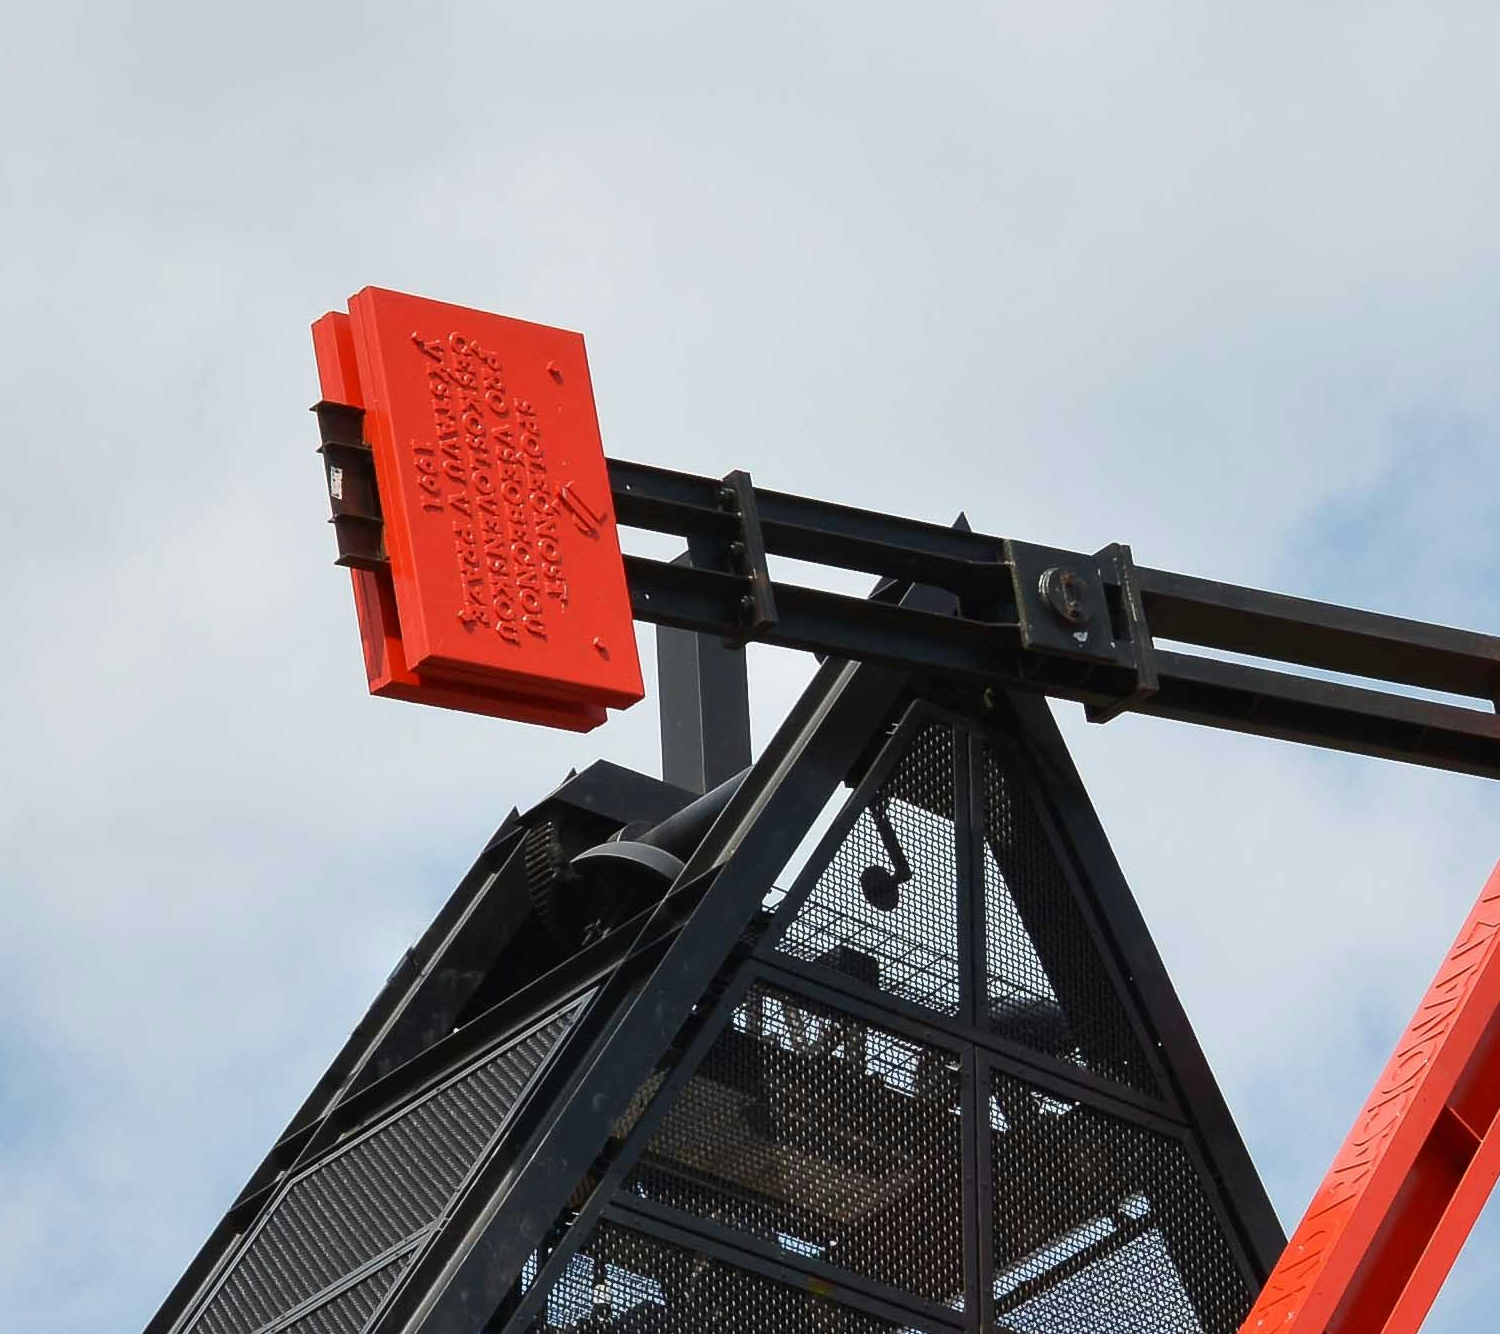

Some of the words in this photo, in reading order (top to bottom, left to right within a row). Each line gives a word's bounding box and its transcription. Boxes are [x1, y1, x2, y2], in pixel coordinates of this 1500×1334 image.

[423, 339, 468, 486] VÝSTAVU
[479, 349, 508, 417] PRO
[410, 439, 444, 514] 1991
[449, 333, 521, 647] ČESKOSLOVENSKOU
[449, 491, 472, 519] V
[492, 424, 547, 641] VŠEOBECNOU
[513, 395, 568, 611] SPOLEČNOST
[453, 520, 490, 629] PRAZE
